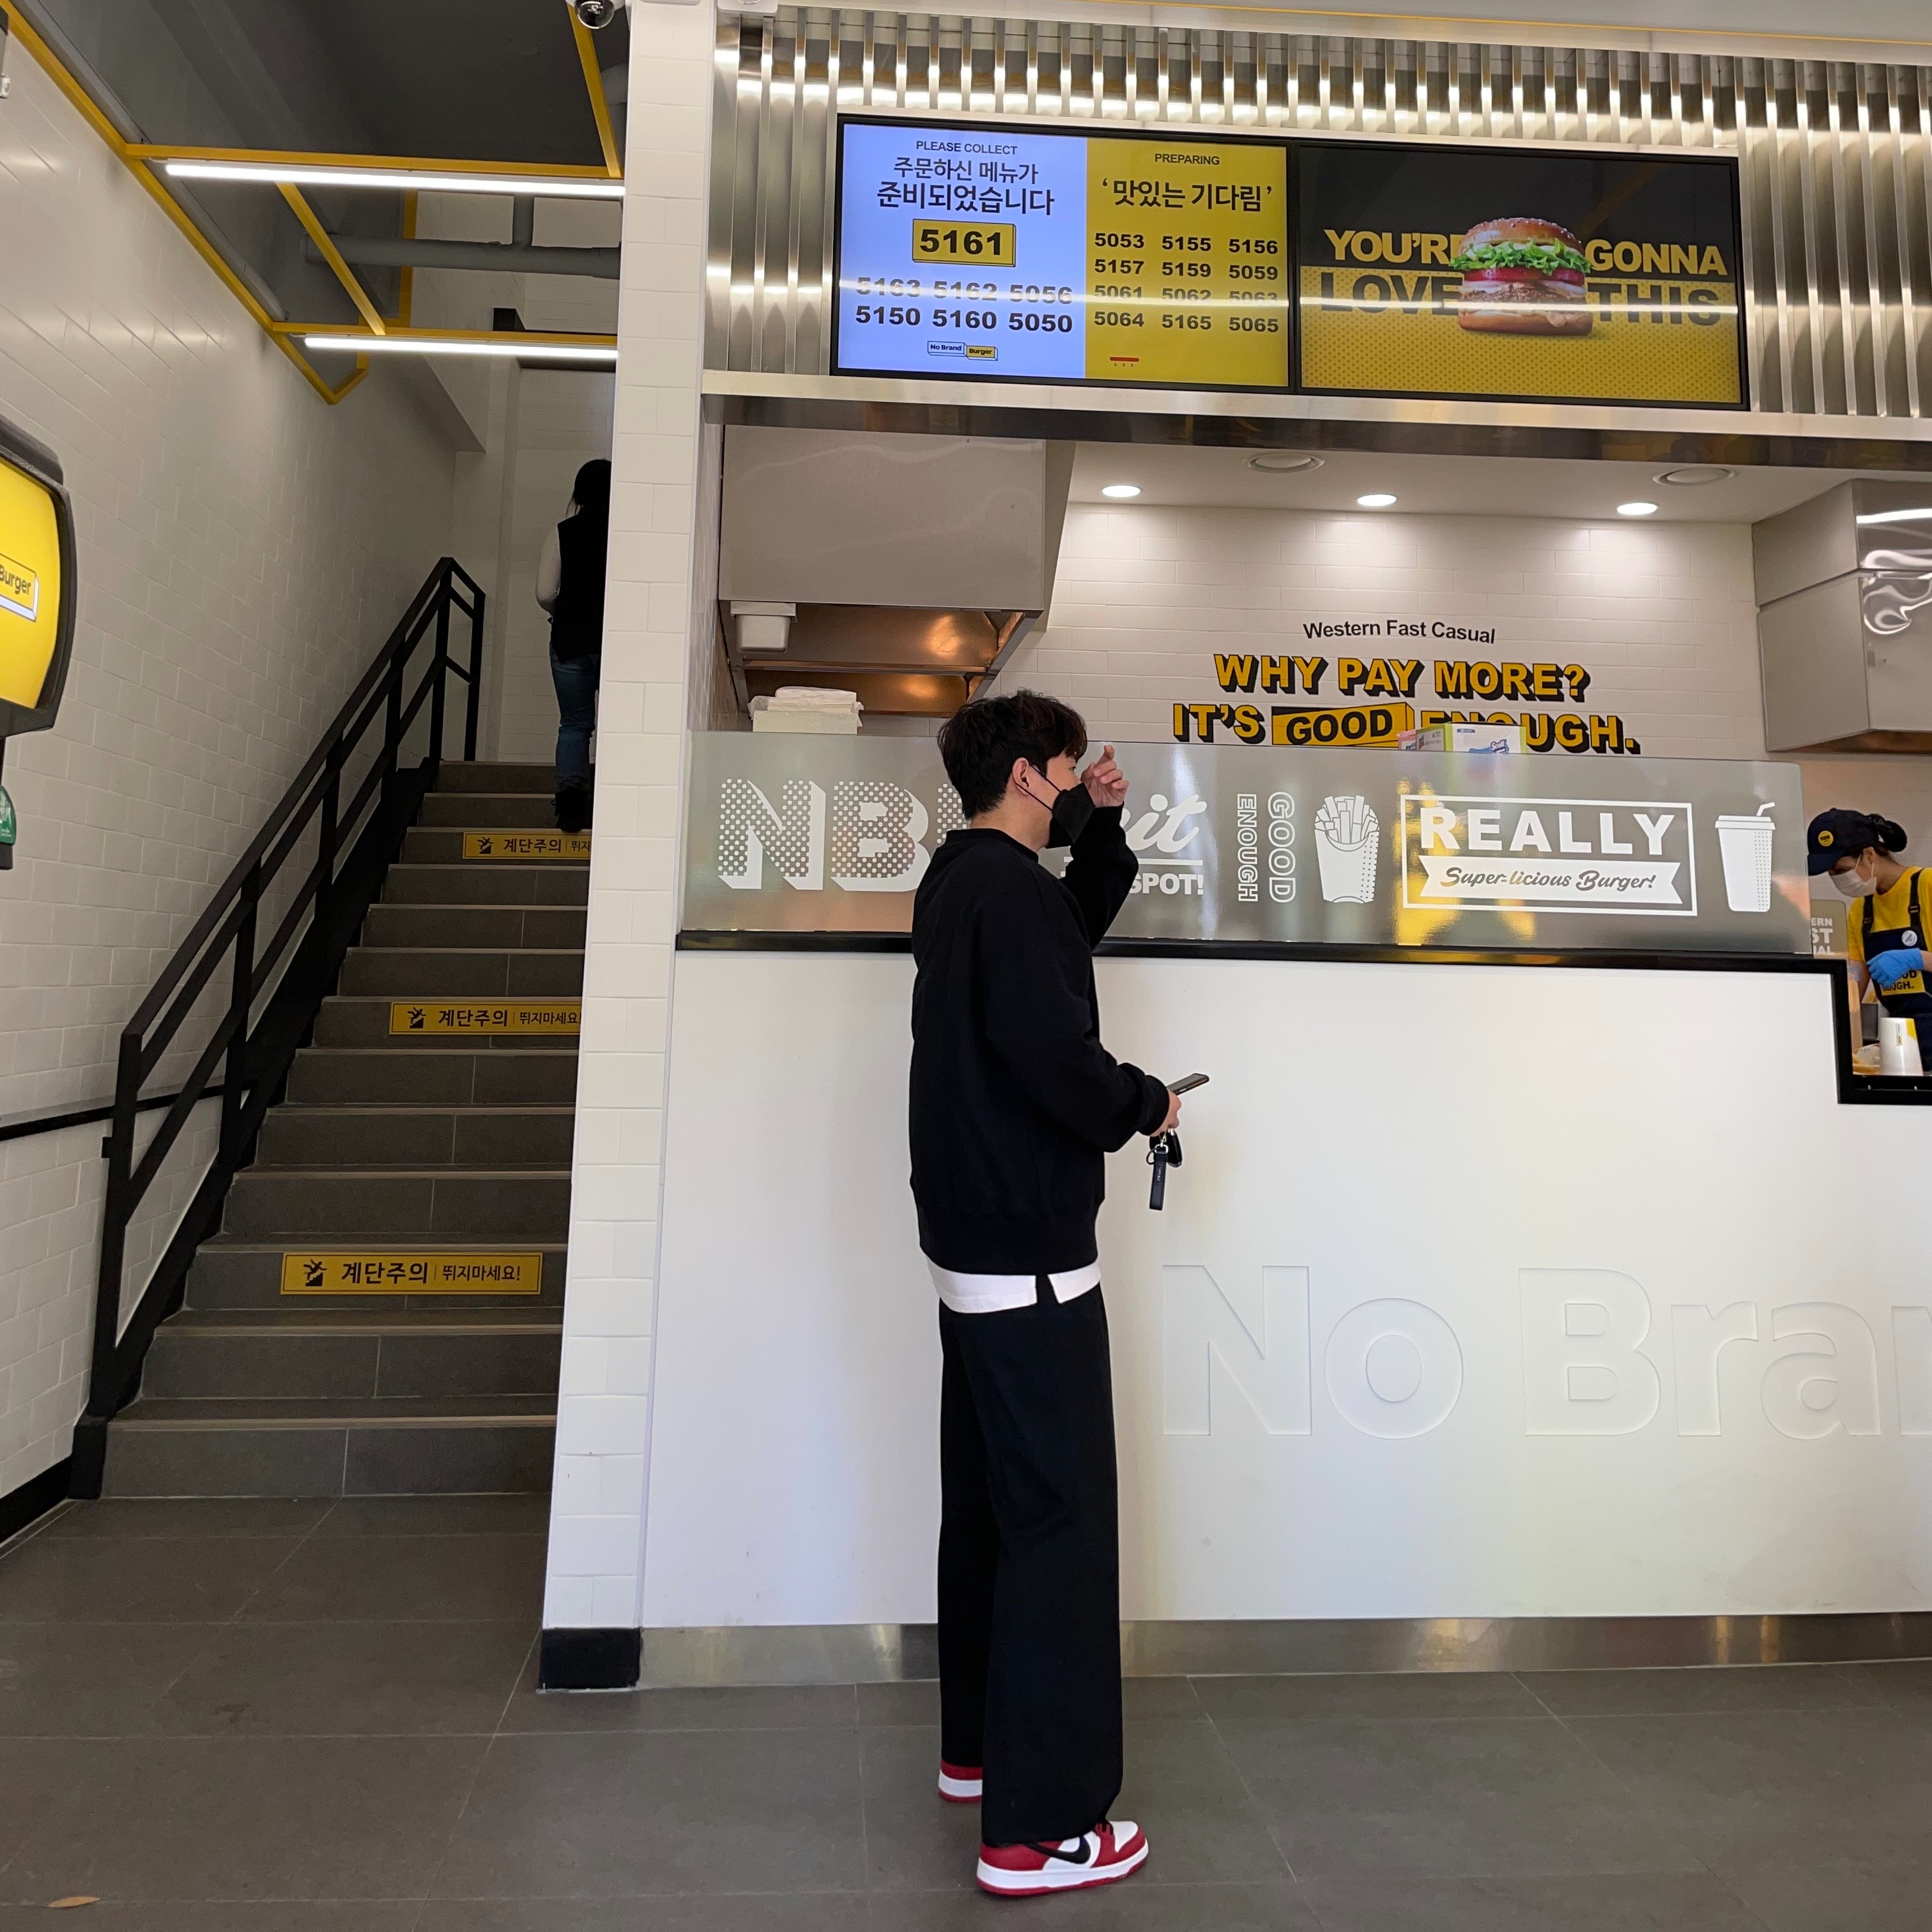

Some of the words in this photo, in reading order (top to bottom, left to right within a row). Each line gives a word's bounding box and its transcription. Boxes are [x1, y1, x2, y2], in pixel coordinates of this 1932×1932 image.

[916, 141, 962, 152] PLEASE
[964, 143, 1018, 155] COLLECT
[1154, 153, 1220, 165] PREPARING
[894, 157, 972, 181] 주문하신
[979, 161, 1039, 185] 메뉴가
[877, 181, 1055, 216] 준비되었습니다
[919, 229, 1001, 256] 5161
[1094, 233, 1144, 249] 5053
[1162, 236, 1211, 252] 5155
[1228, 238, 1278, 254] 5156
[1094, 258, 1144, 275] 5157
[1162, 261, 1211, 277] 5159
[1229, 264, 1278, 280] 5059
[1584, 238, 1728, 276] GONNA
[856, 277, 921, 297] 5163
[933, 280, 997, 301] 5162
[1009, 284, 1073, 305] 5056
[1094, 285, 1142, 300] 5061
[1162, 288, 1211, 303] 5062
[1321, 272, 1463, 316] LOVE
[1587, 282, 1721, 326] THIS
[855, 305, 921, 326] 5150
[932, 309, 997, 329] 5160
[1008, 312, 1073, 333] 5050
[1094, 311, 1144, 327] 5064
[1162, 314, 1211, 330] 5165
[1229, 317, 1279, 333] 5065
[1303, 621, 1381, 639] Western
[1386, 619, 1427, 637] Fast
[1431, 621, 1496, 644] Casual
[1213, 654, 1329, 695] WHY
[1338, 657, 1425, 698] PAY
[1434, 660, 1591, 703] MORE?
[1173, 703, 1266, 744] IT'S
[1285, 709, 1393, 745] GOOD
[1420, 807, 1675, 856] REALLY
[503, 838, 562, 854] 계단주의
[571, 840, 590, 852] 뛰지
[1237, 793, 1259, 901] ENOUGH
[1268, 791, 1296, 903] GOOD
[1439, 866, 1572, 889] Super-licious
[1575, 870, 1657, 892] Burger!
[438, 1009, 509, 1027] 계단주의
[341, 1261, 429, 1285] 계단주의
[442, 1264, 521, 1282] 뛰지마세요!
[1162, 1264, 1464, 1440] No
